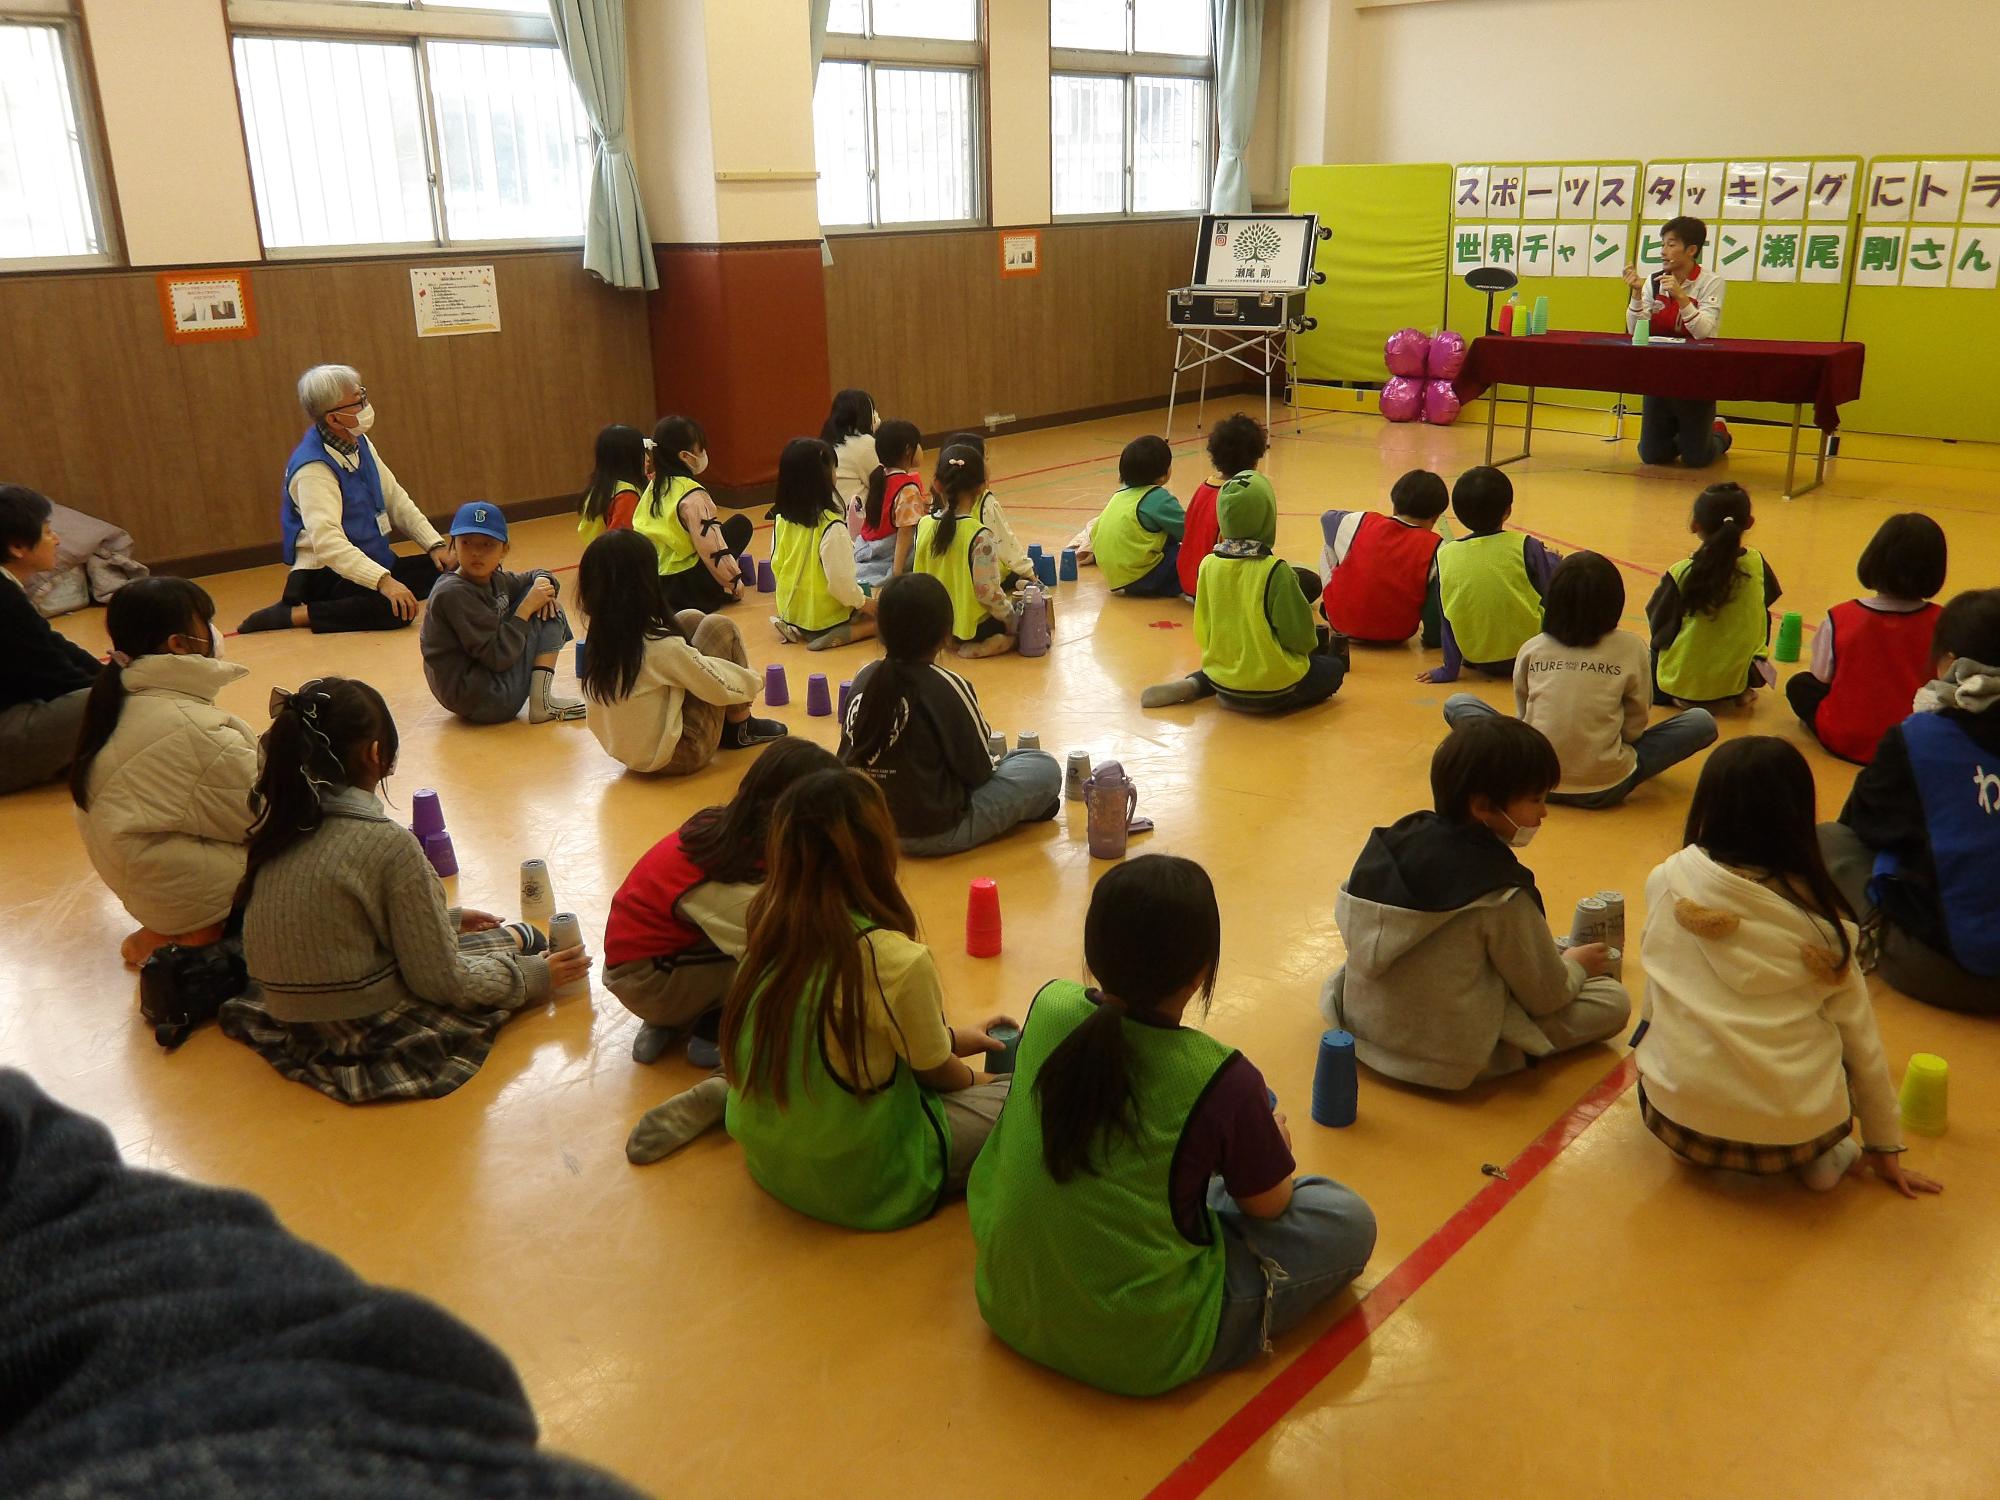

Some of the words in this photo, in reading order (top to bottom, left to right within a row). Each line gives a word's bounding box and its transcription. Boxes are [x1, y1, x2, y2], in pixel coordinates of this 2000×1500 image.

[1456, 232, 1992, 272] 世界チャンピン瀬尾剛さん
[1529, 661, 1563, 672] ATURE
[1580, 662, 1621, 675] PARKS
